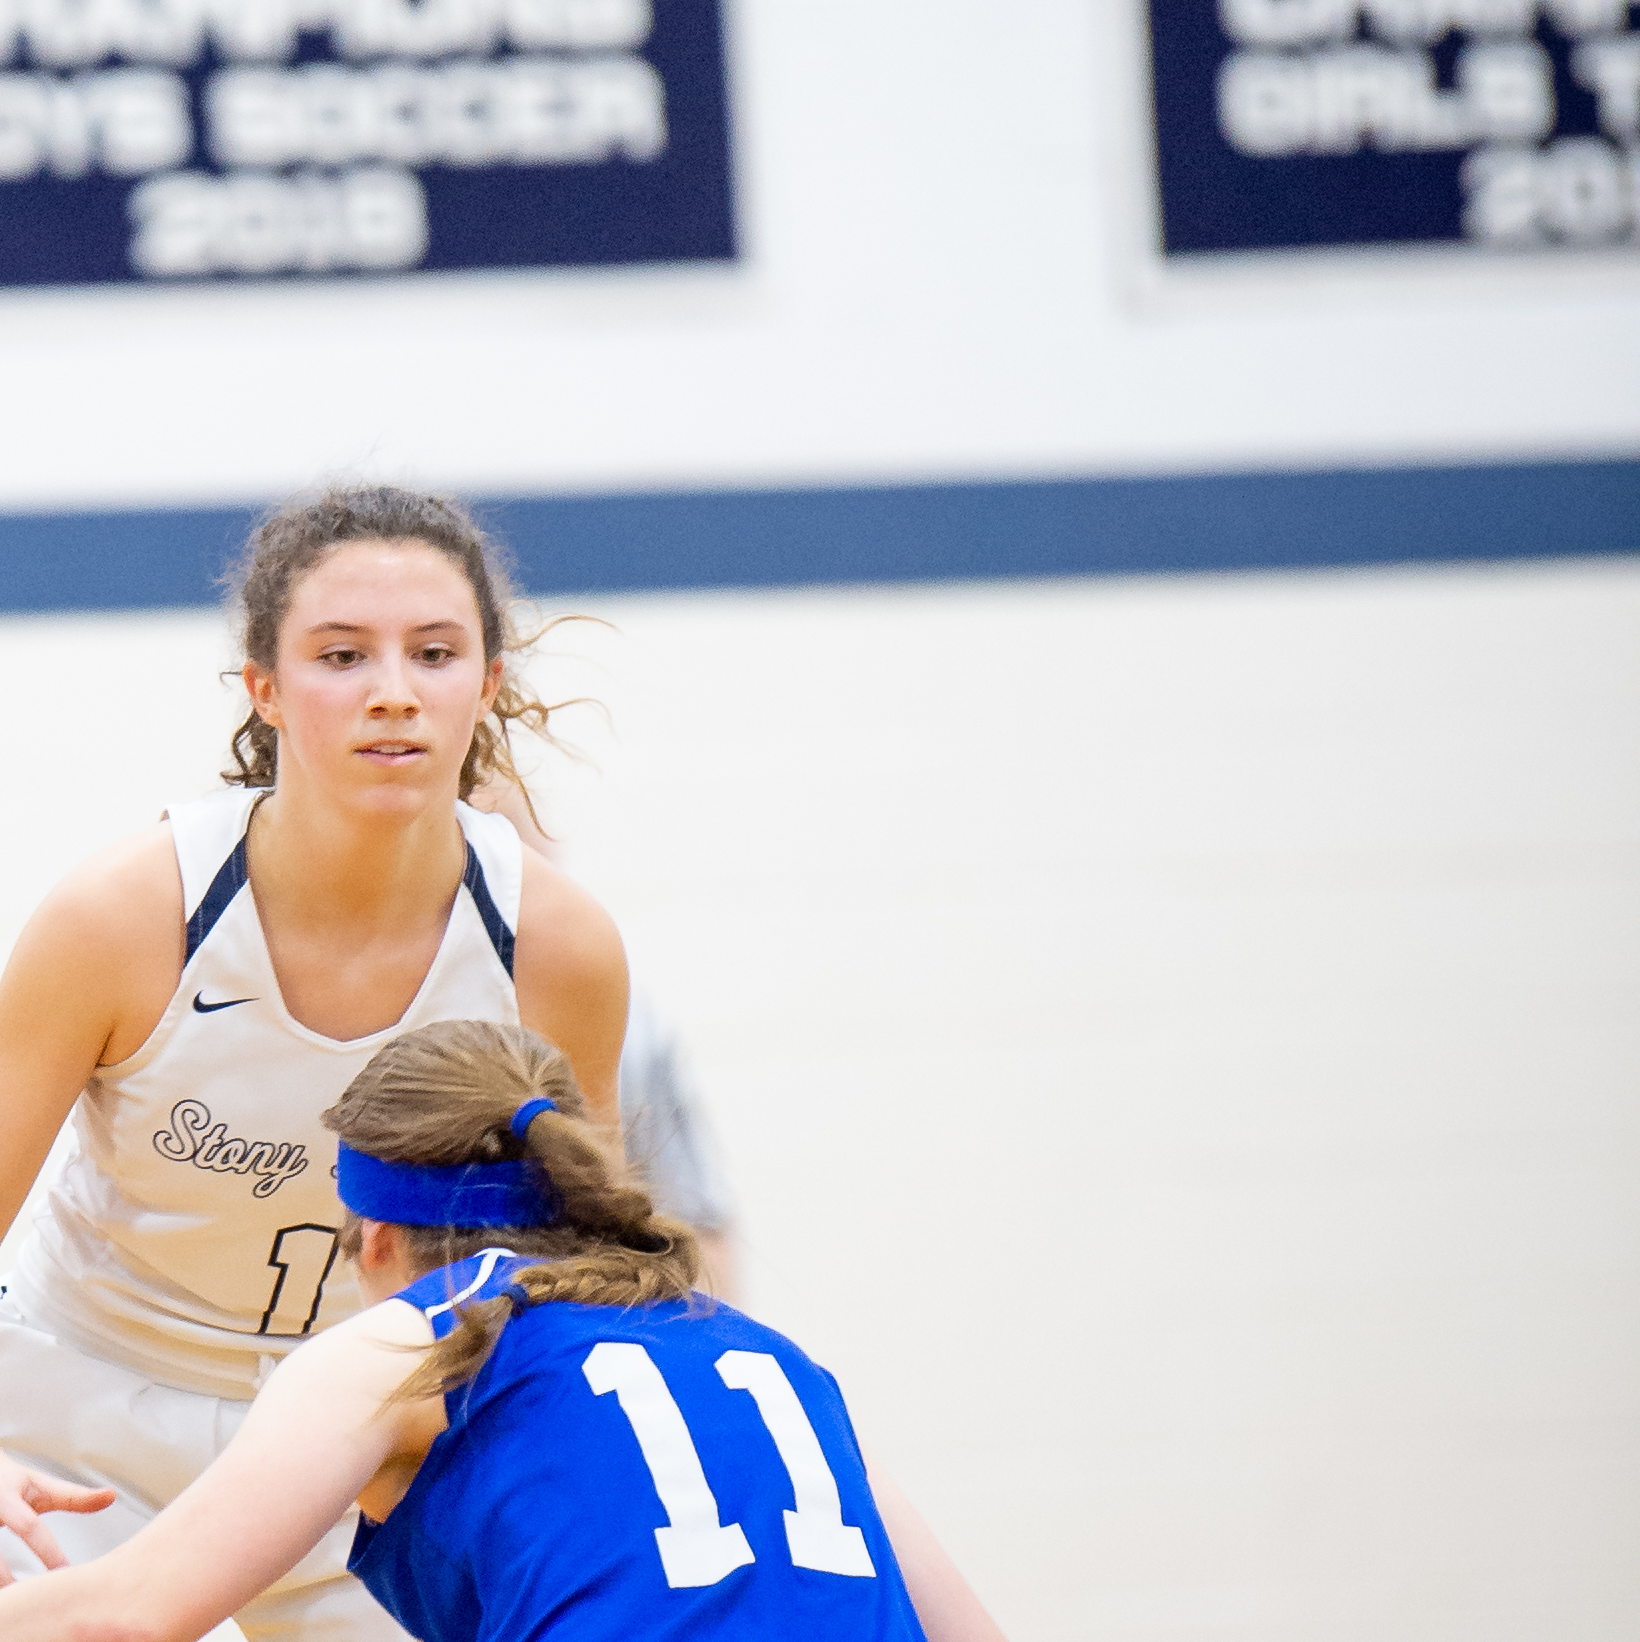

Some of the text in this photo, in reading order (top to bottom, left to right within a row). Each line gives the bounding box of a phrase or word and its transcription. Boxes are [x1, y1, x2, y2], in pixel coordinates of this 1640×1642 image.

[201, 54, 666, 173] SOCCER
[1216, 40, 1556, 157] GIRLS
[153, 1099, 308, 1198] Stony
[581, 1341, 876, 1589] 11
